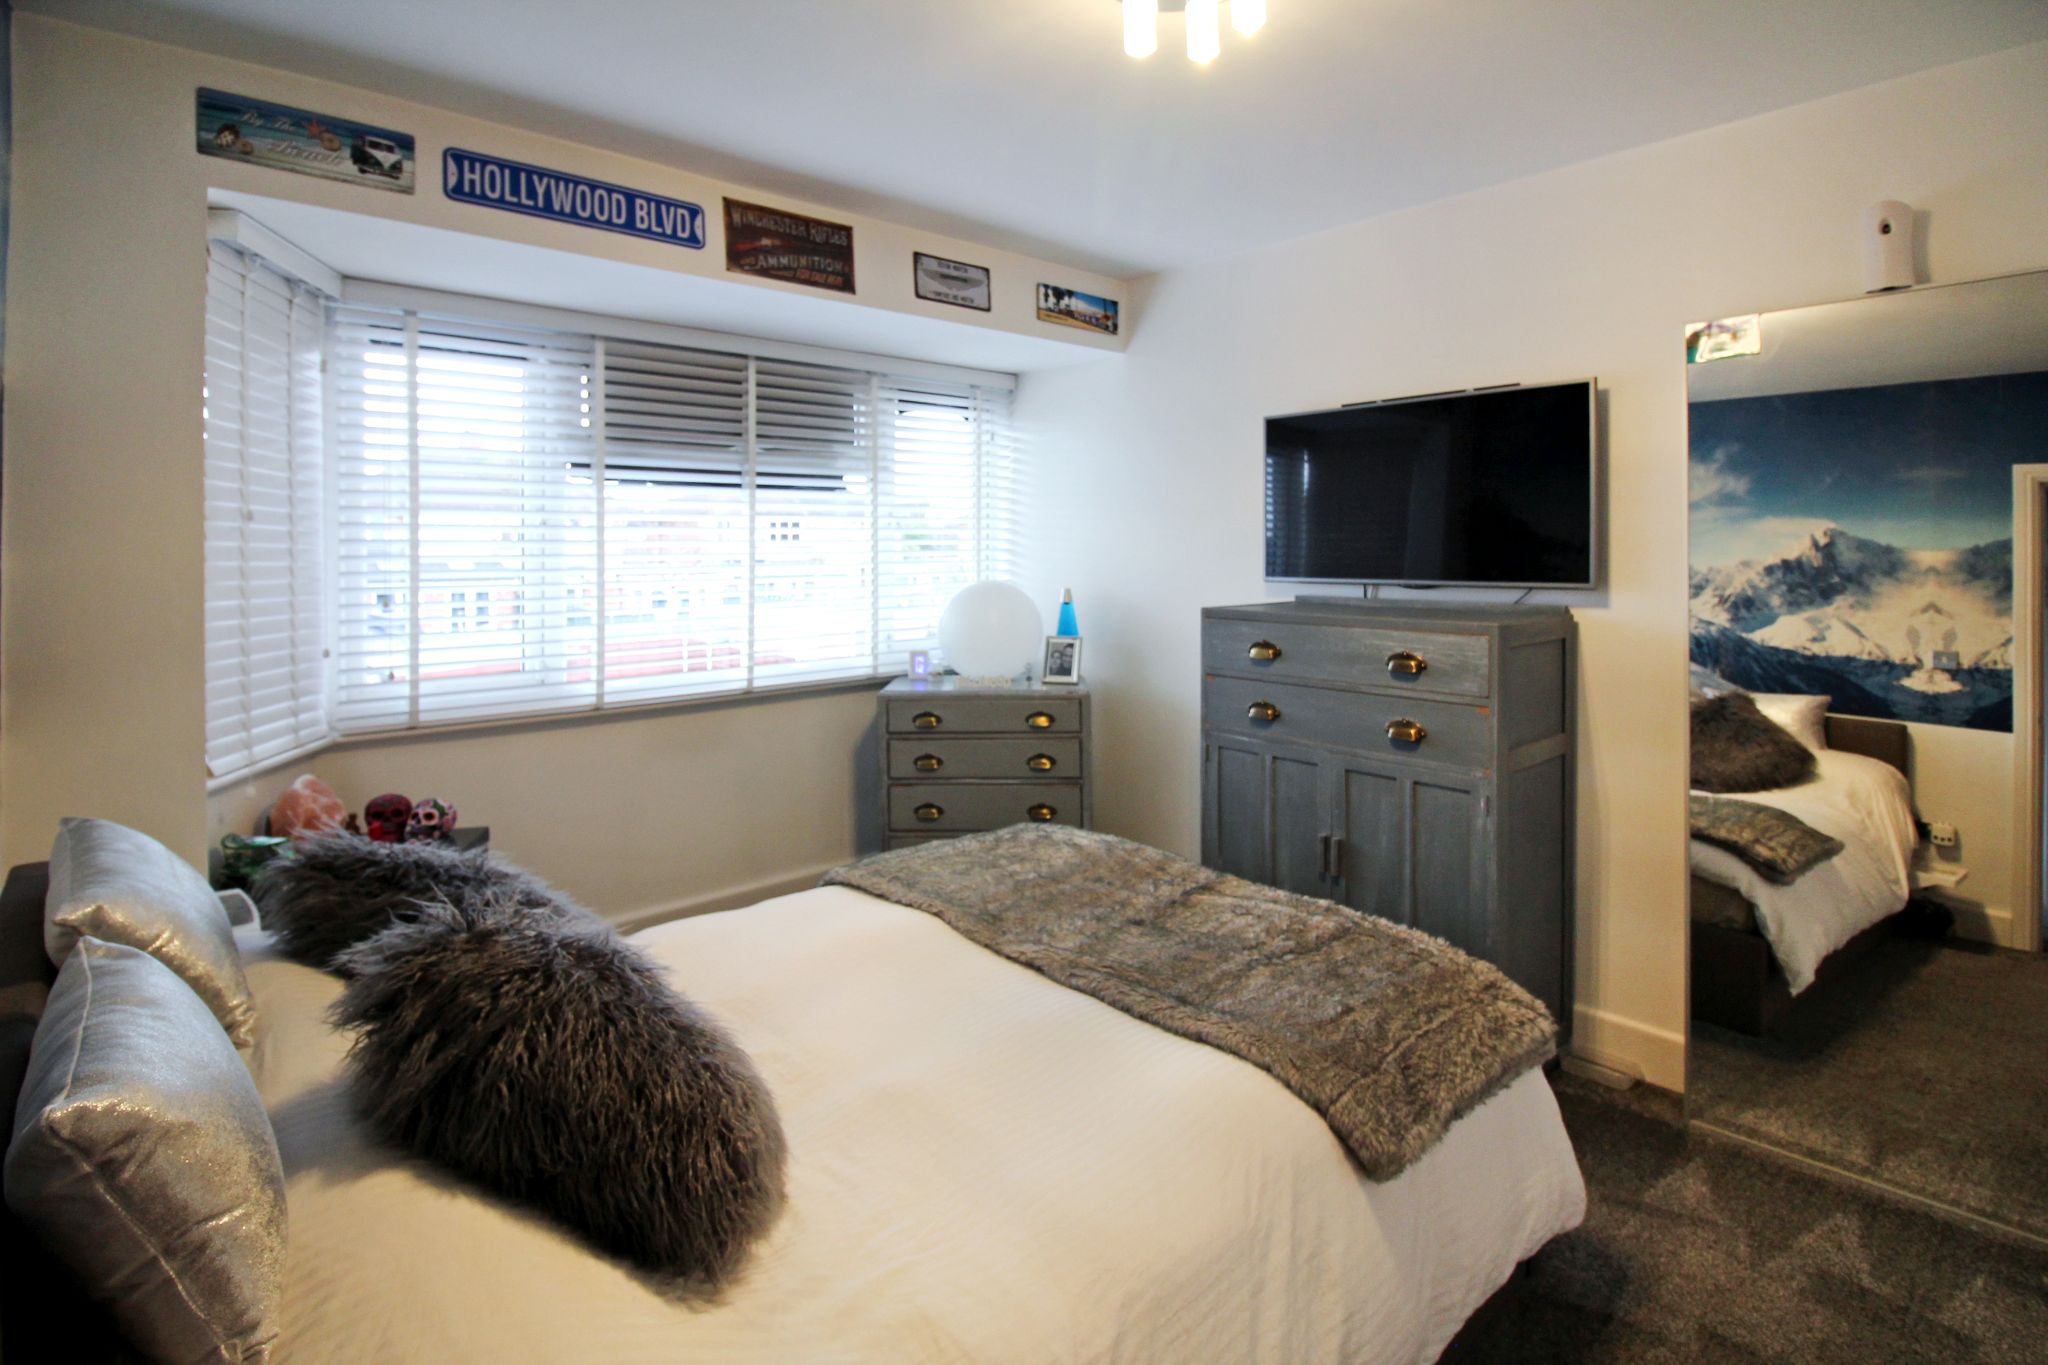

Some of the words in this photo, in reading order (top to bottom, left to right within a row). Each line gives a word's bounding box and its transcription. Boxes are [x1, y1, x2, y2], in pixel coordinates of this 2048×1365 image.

[462, 159, 627, 225] HOLLYWOOD
[634, 198, 691, 239] BLVD
[757, 254, 844, 274] AMMUNITION
